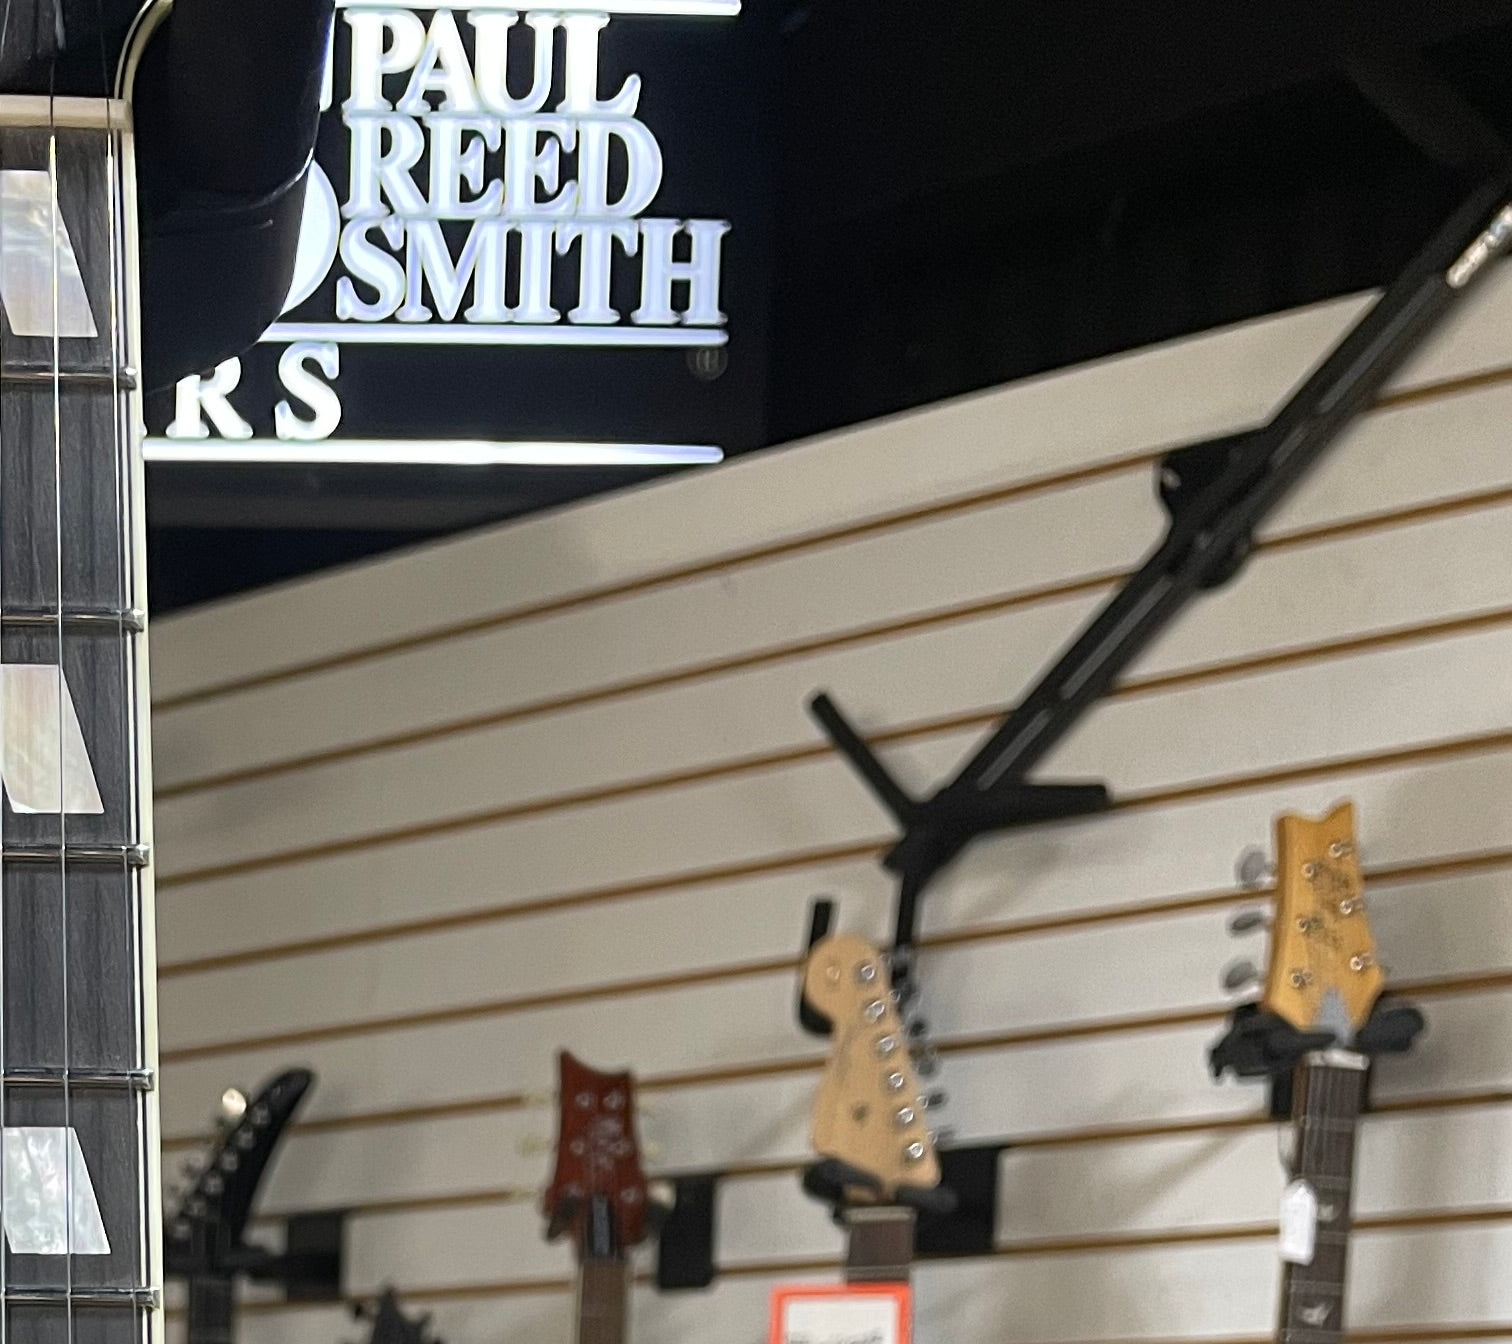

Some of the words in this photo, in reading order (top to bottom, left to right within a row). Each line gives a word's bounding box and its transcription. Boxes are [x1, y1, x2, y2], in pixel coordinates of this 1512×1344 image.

[341, 9, 642, 114] PAUL
[340, 114, 663, 218] REED
[335, 217, 731, 324] SMITH
